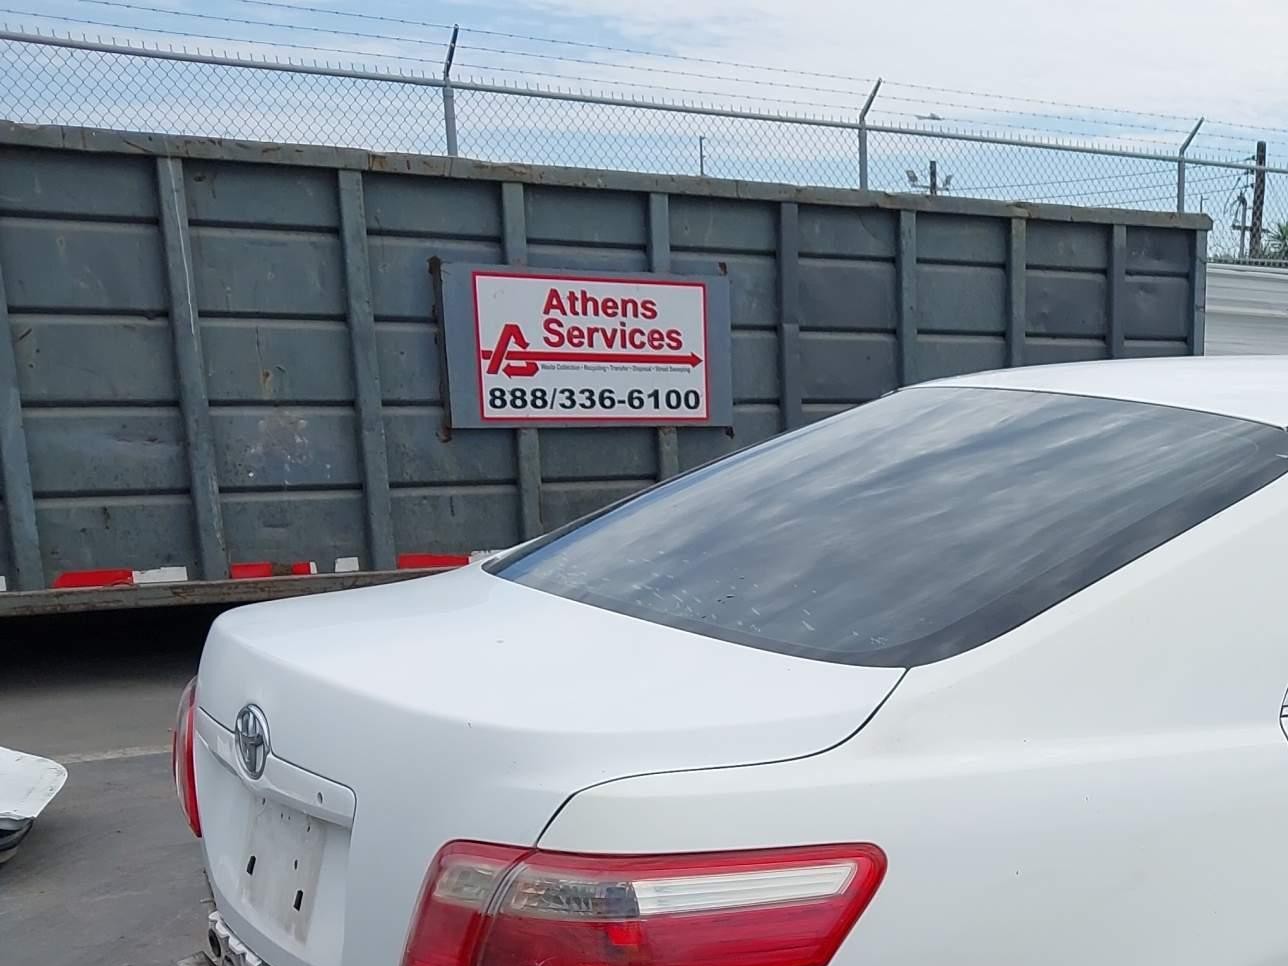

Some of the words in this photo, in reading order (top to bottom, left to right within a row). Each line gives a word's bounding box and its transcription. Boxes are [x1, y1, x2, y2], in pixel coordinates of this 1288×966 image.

[543, 288, 658, 320] Athens
[543, 318, 683, 350] Services
[488, 388, 700, 411] 888/336-6100
